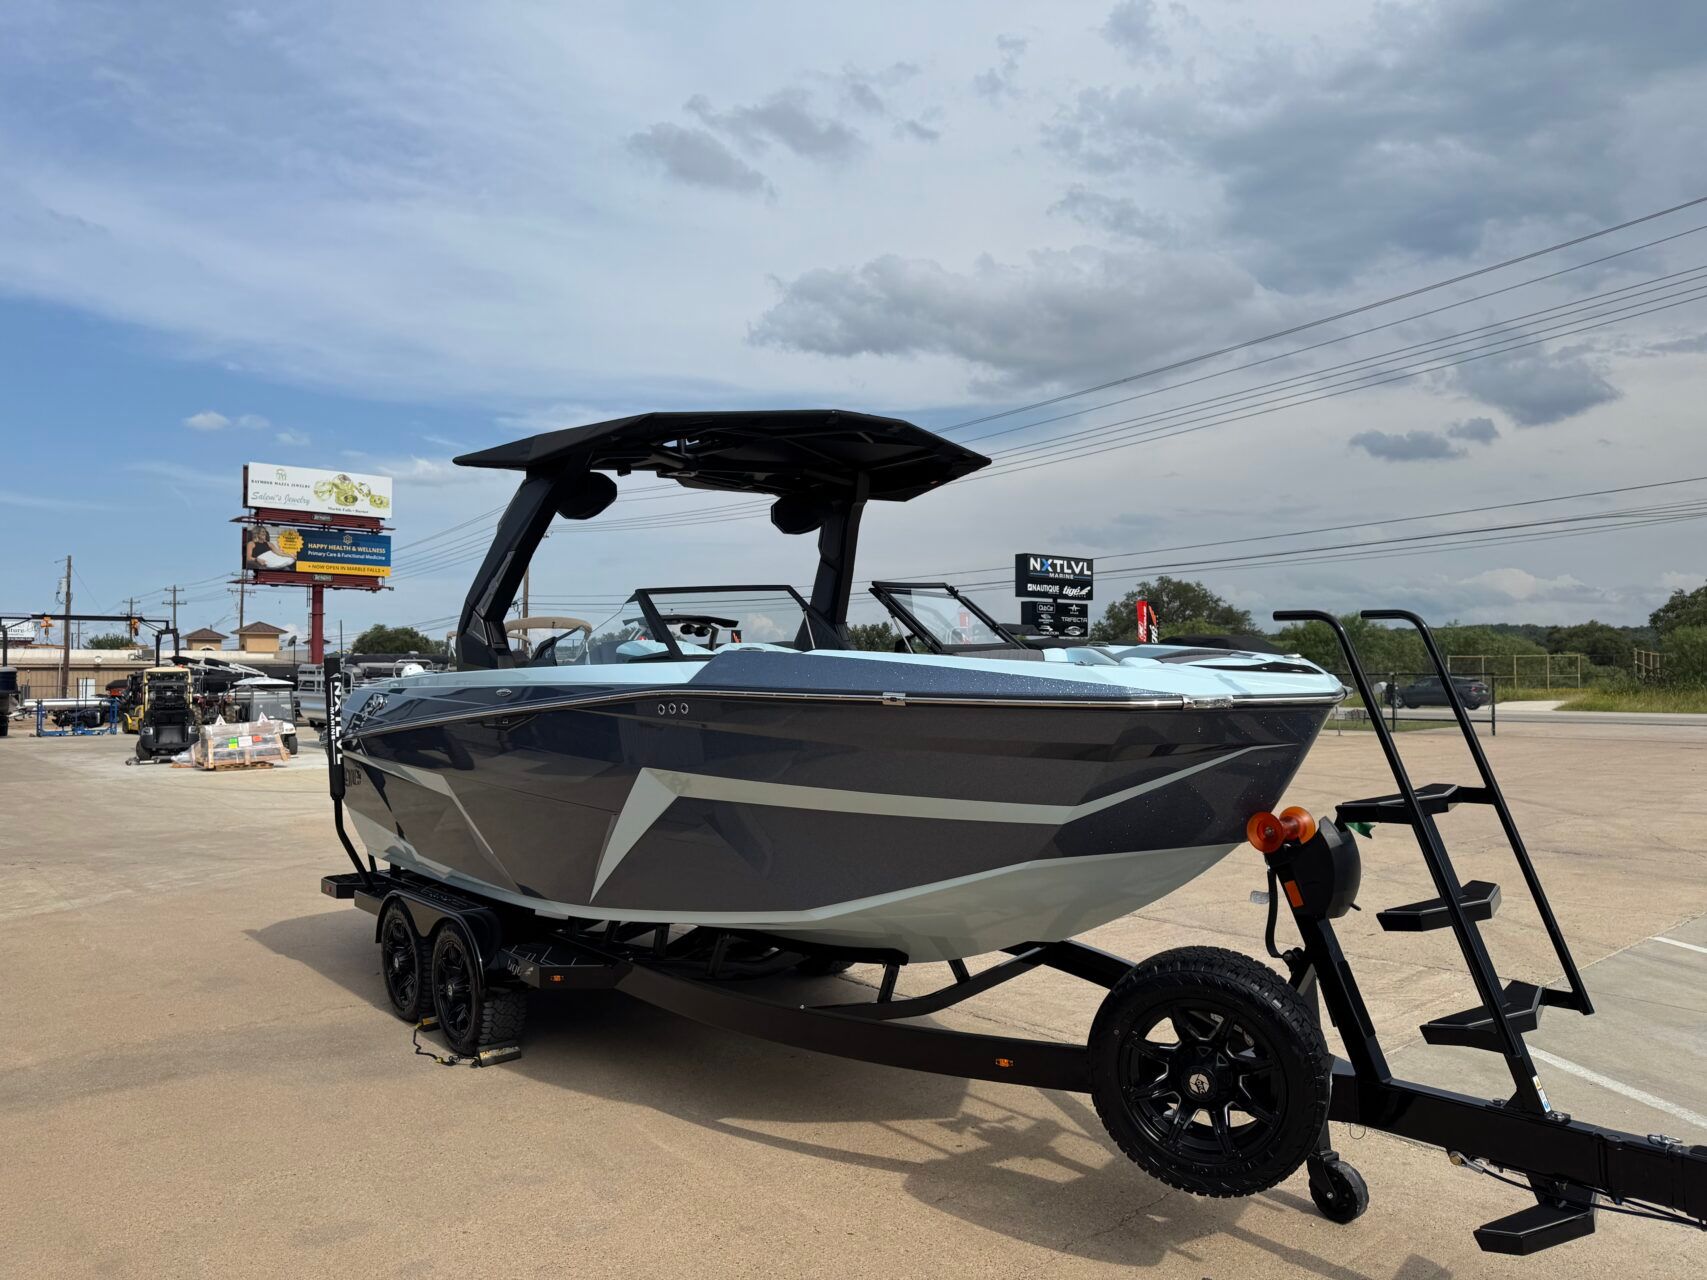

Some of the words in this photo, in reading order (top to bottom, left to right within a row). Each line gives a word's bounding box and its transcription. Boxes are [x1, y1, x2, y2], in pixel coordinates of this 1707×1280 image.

[284, 493, 311, 506] Jewelry
[328, 543, 351, 551] HEALTH
[1030, 557, 1092, 575] NXTLVL
[1032, 584, 1060, 592] NAUTIQUE
